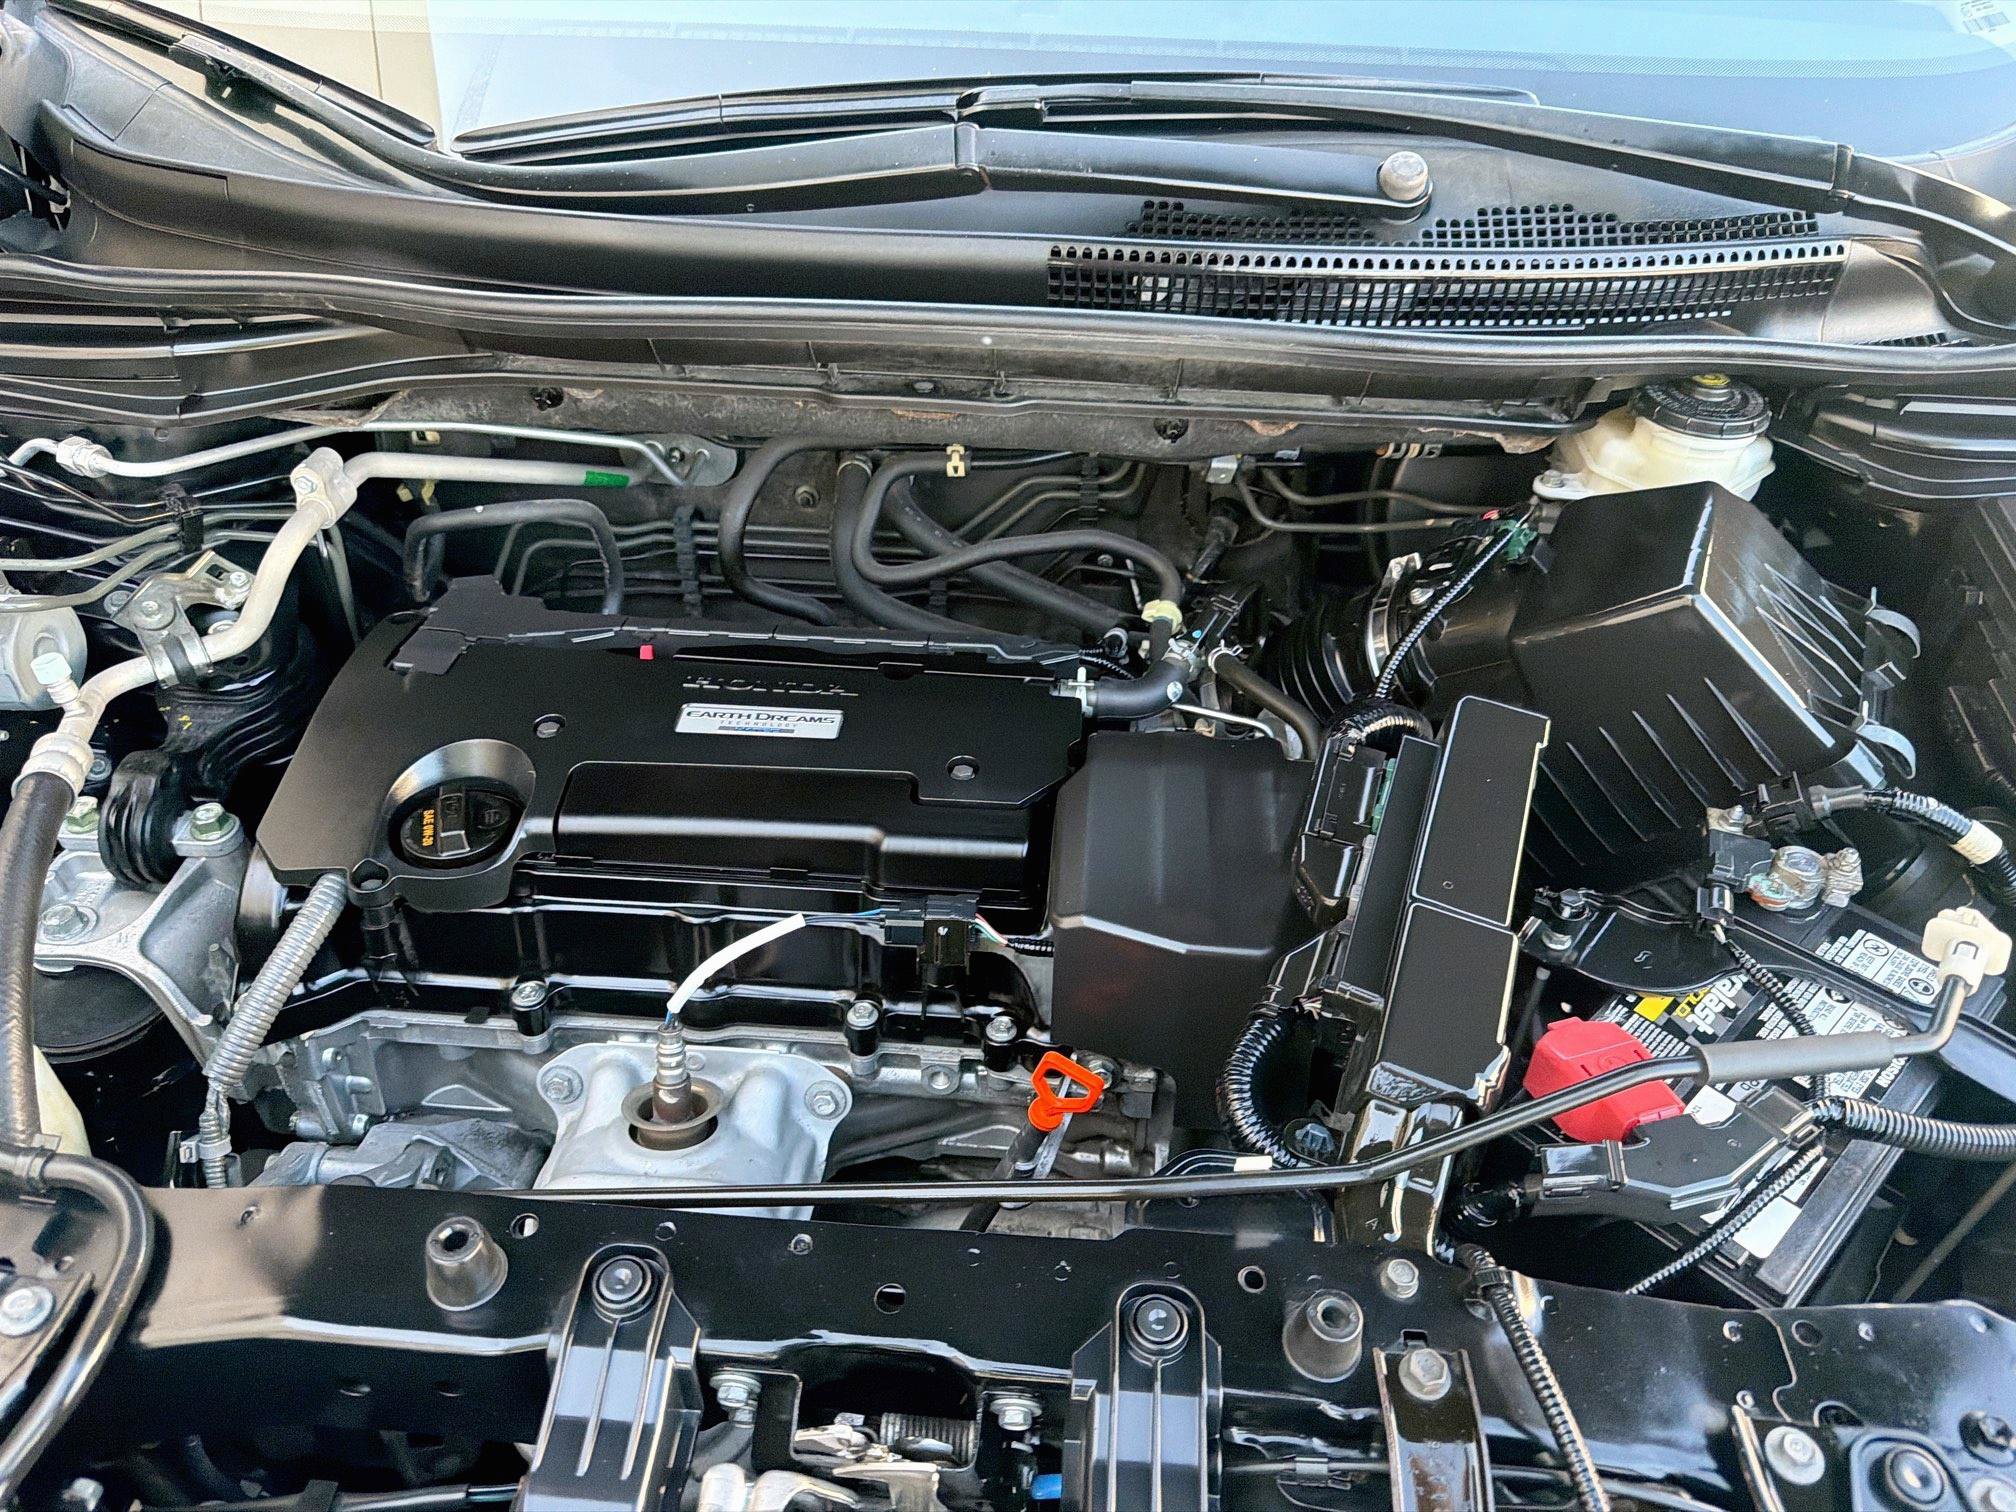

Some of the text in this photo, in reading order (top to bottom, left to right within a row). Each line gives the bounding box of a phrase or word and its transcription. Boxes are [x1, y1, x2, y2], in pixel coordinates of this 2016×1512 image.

[686, 710, 835, 724] EARTH DREAMS
[720, 720, 797, 728] TECHNOLOGY
[422, 809, 435, 846] SAE 0W-20
